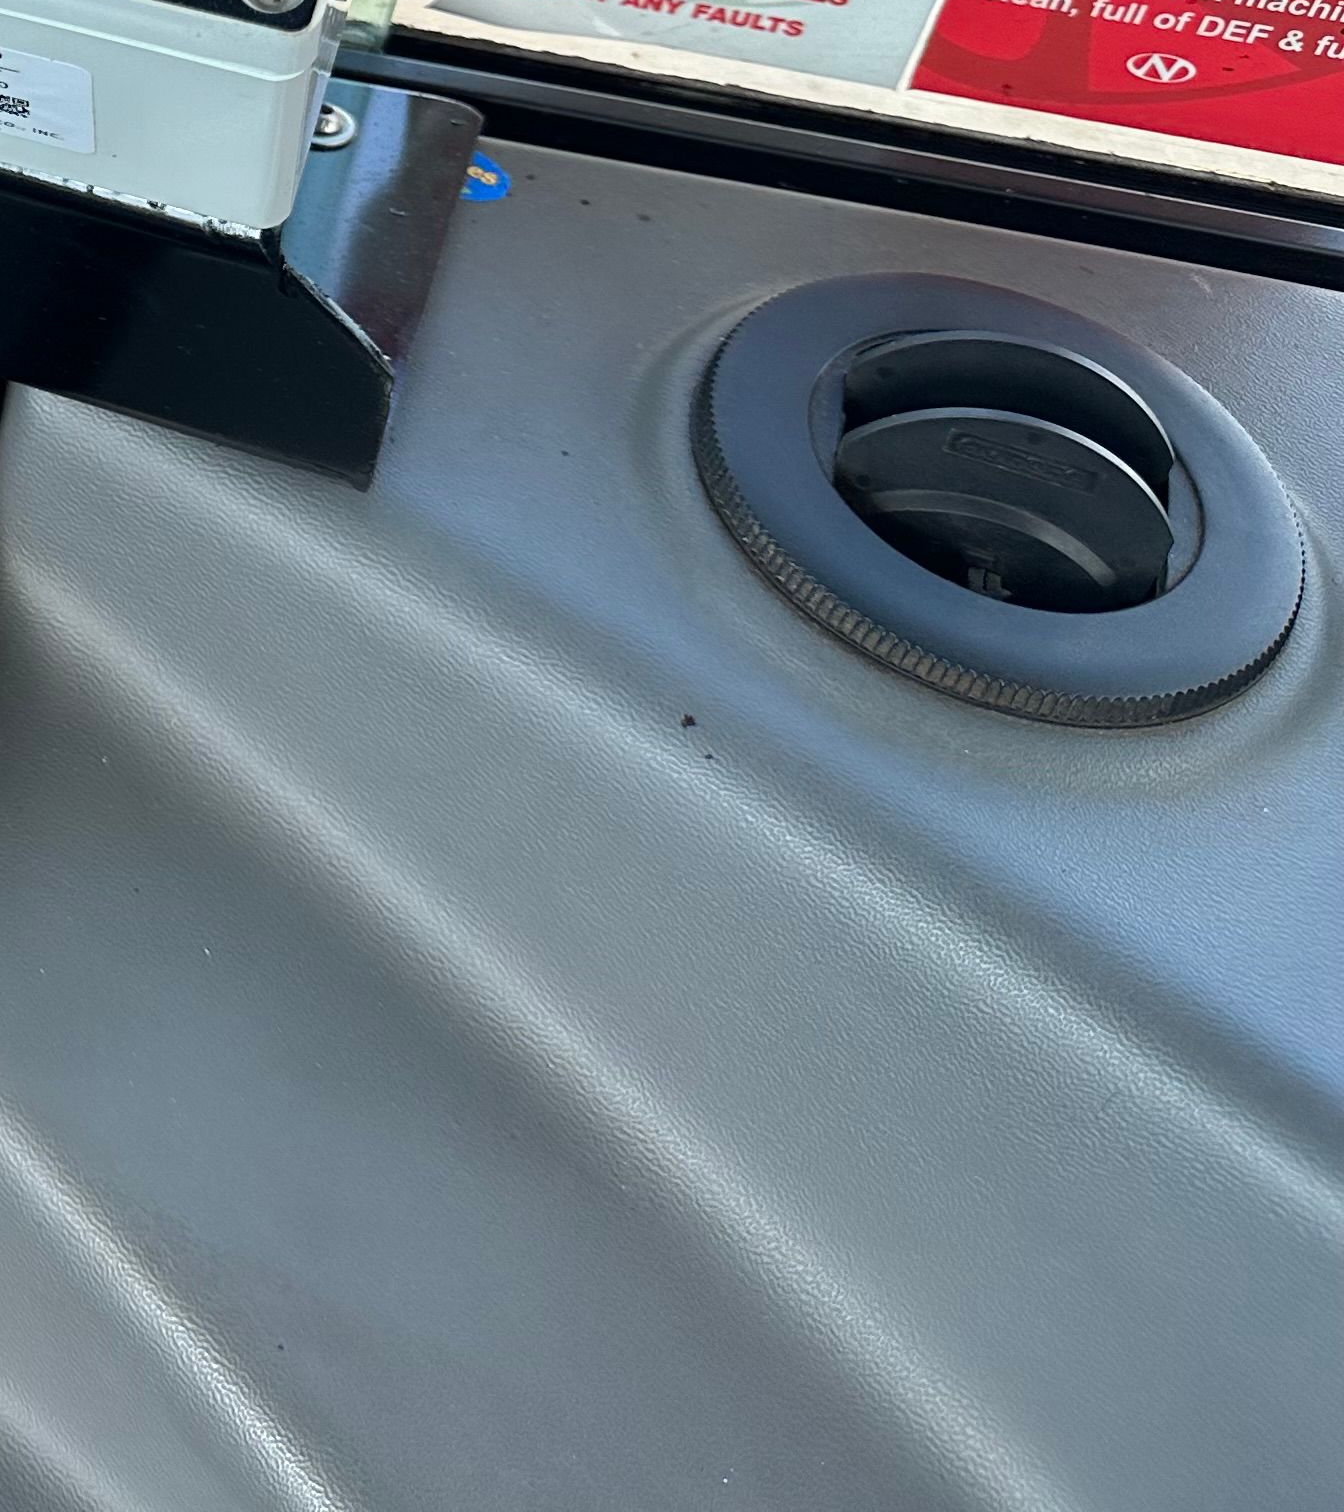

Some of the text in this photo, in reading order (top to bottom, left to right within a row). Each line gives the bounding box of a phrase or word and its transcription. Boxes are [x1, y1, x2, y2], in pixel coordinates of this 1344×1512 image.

[691, 4, 804, 37] FAULTS
[1152, 10, 1194, 33] of
[1197, 14, 1276, 46] DEF
[1278, 29, 1305, 53] &
